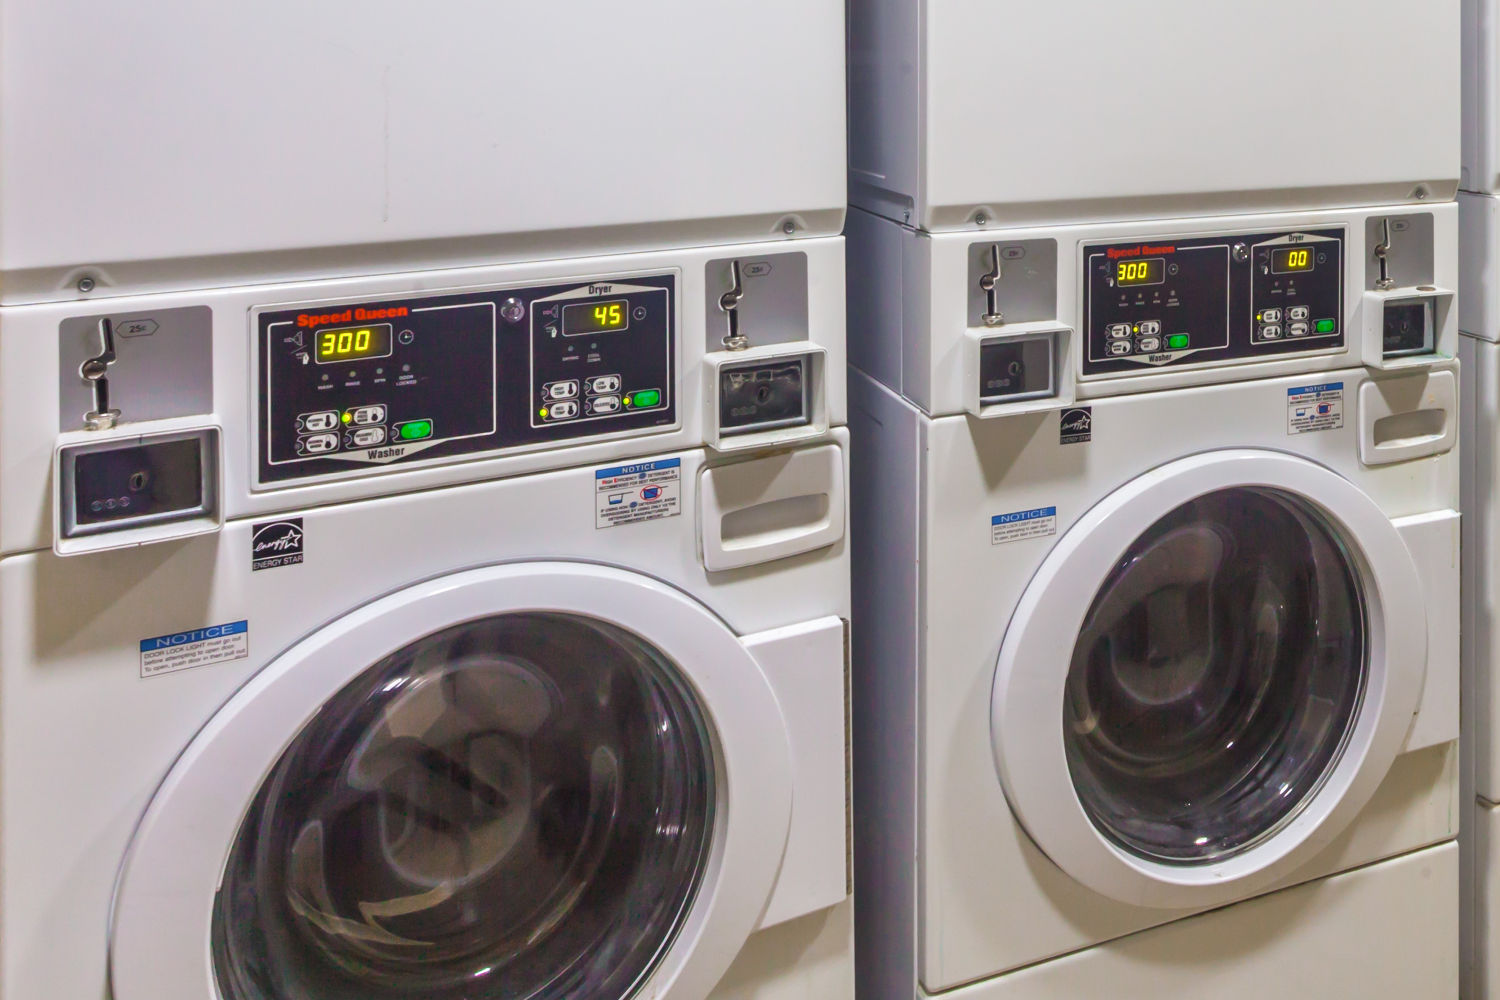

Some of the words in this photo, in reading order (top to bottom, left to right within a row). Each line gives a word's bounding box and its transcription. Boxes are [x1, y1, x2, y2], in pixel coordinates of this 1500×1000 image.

[1107, 246, 1140, 259] Speed
[1142, 245, 1175, 255] Queen
[1288, 250, 1307, 267] 00
[1118, 262, 1147, 280] 300
[588, 285, 612, 296] Dryer
[297, 309, 352, 328] Speed
[354, 306, 408, 321] Queen
[594, 305, 621, 325] 45
[322, 330, 370, 355] 300
[1148, 353, 1172, 362] Washer
[368, 447, 405, 460] Washer
[622, 462, 656, 474] NOTICE
[1001, 508, 1047, 522] NOTICE
[253, 558, 282, 570] ENERGY
[283, 555, 303, 564] STAR
[156, 624, 234, 647] NOTICE
[166, 647, 184, 655] LOCK
[186, 643, 206, 651] LIGHT
